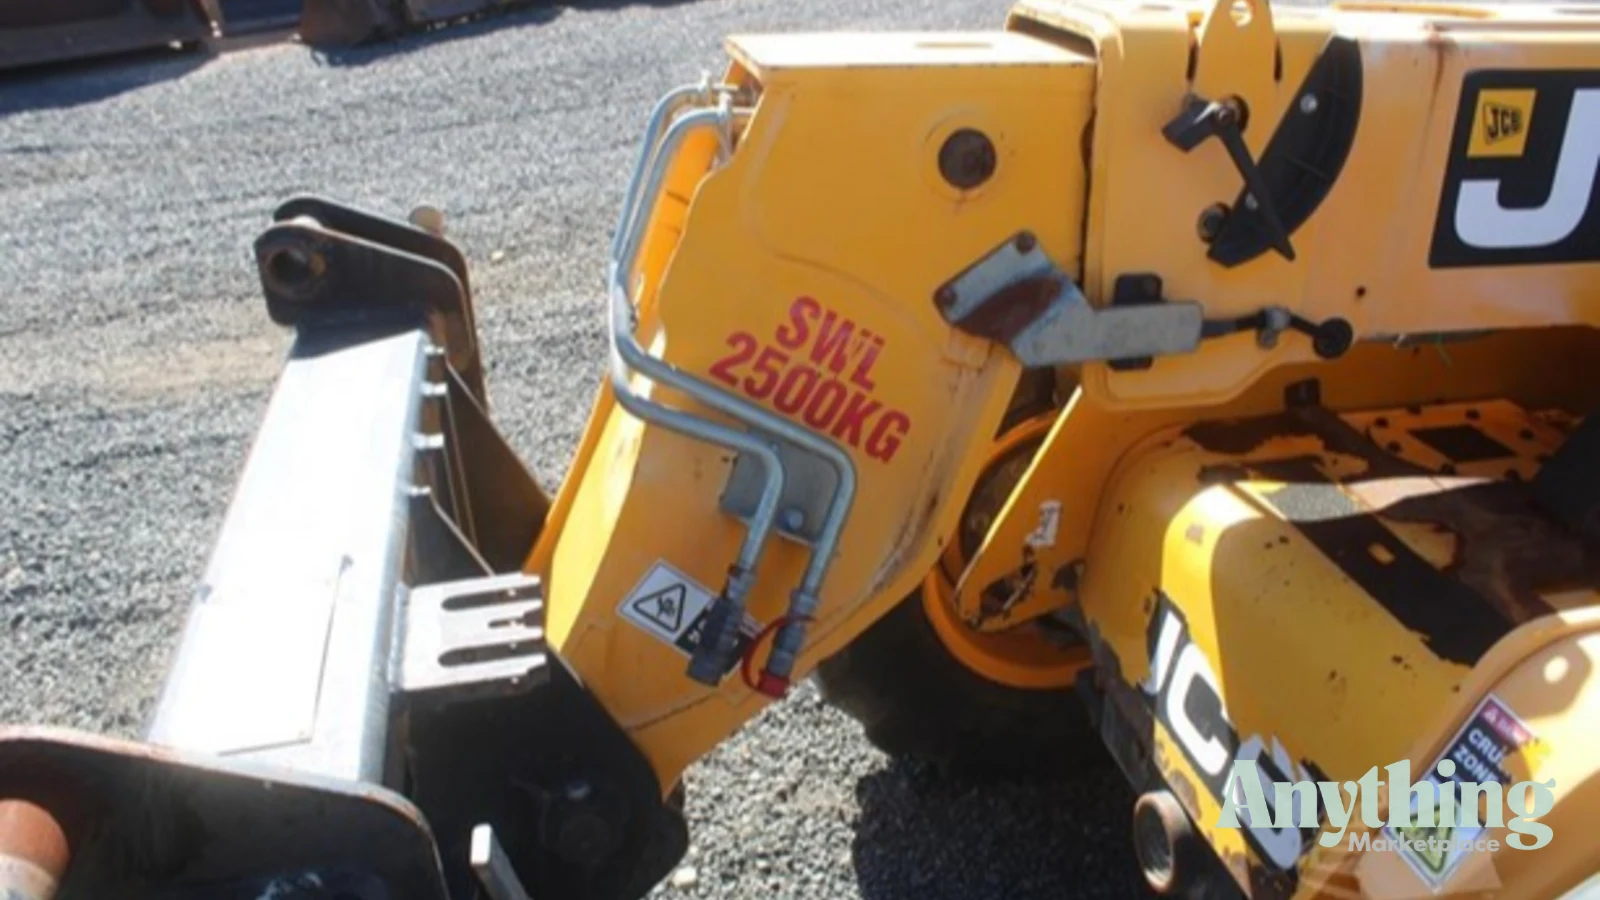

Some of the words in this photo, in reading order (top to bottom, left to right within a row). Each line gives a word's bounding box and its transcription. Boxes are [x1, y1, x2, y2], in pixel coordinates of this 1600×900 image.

[1486, 105, 1523, 139] JCB
[776, 295, 885, 392] SWL
[708, 331, 910, 464] 2500KG
[1468, 727, 1507, 767] CRU
